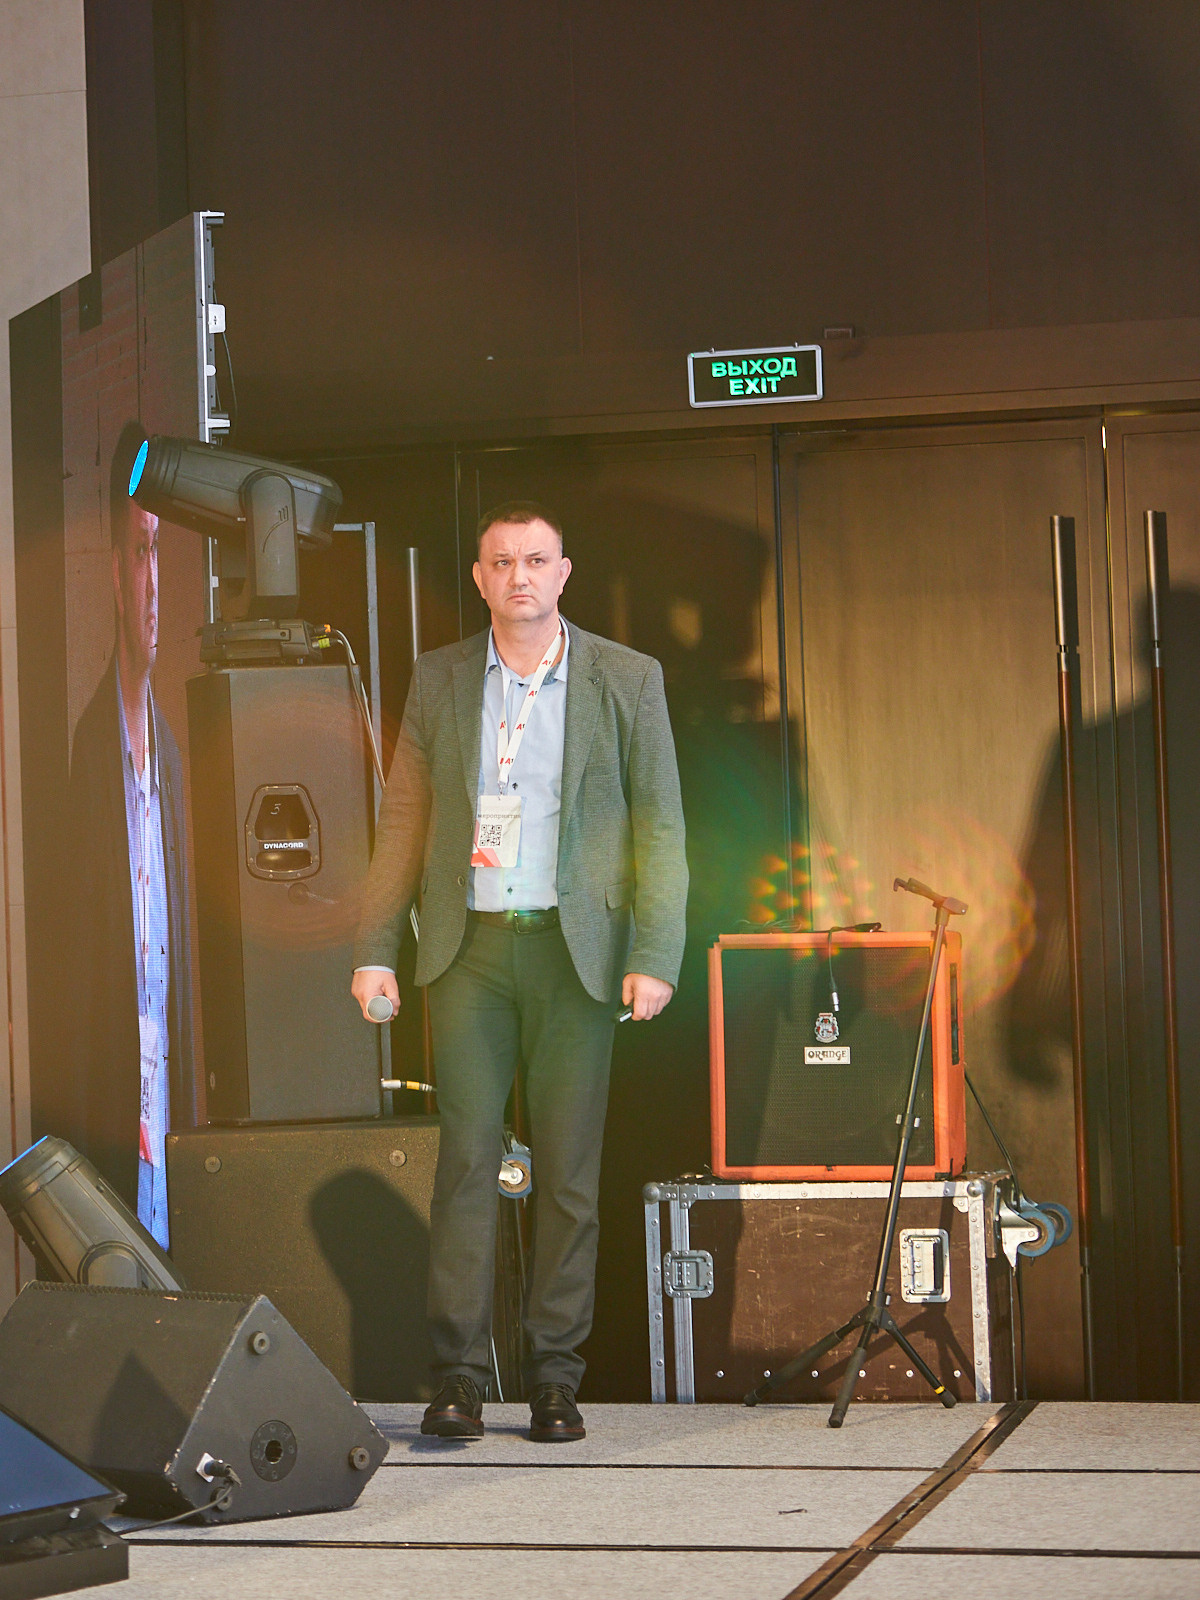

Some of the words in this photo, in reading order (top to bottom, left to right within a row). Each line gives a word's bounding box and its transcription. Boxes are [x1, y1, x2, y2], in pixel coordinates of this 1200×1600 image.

[711, 356, 798, 378] ВЫХОД
[729, 376, 781, 396] EXIT
[263, 842, 304, 850] DYNACORD
[807, 1050, 847, 1061] ORANGE
